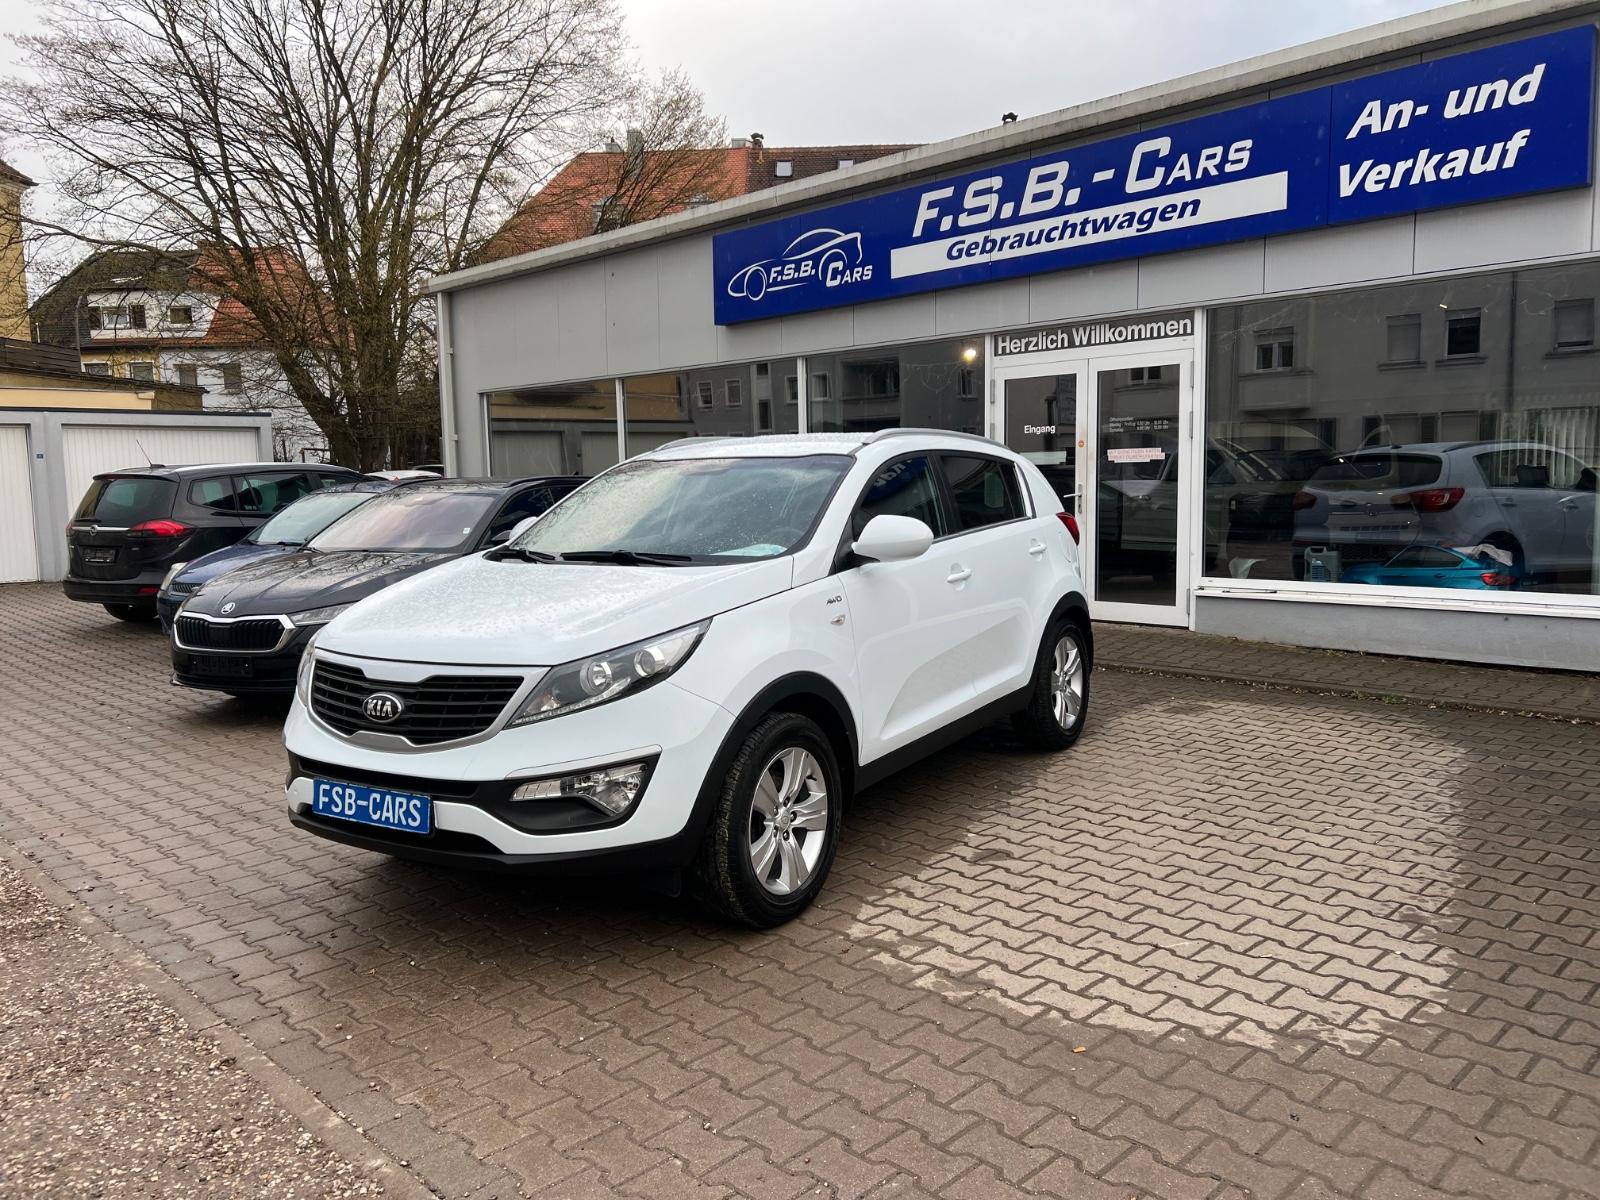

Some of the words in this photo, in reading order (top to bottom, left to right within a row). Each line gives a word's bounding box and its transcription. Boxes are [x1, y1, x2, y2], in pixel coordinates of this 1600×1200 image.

[1345, 99, 1429, 140] An-
[1443, 63, 1546, 119] und
[1339, 128, 1531, 198] Verkauf
[946, 198, 1201, 261] Gebrauchtwagen
[769, 260, 816, 283] F.S.B.
[826, 260, 873, 287] CARS
[997, 329, 1068, 355] Herzlich
[1072, 318, 1192, 346] Willkommen
[1024, 424, 1056, 435] Eingang
[366, 698, 393, 718] KIA
[318, 783, 421, 827] FSB-CARS
